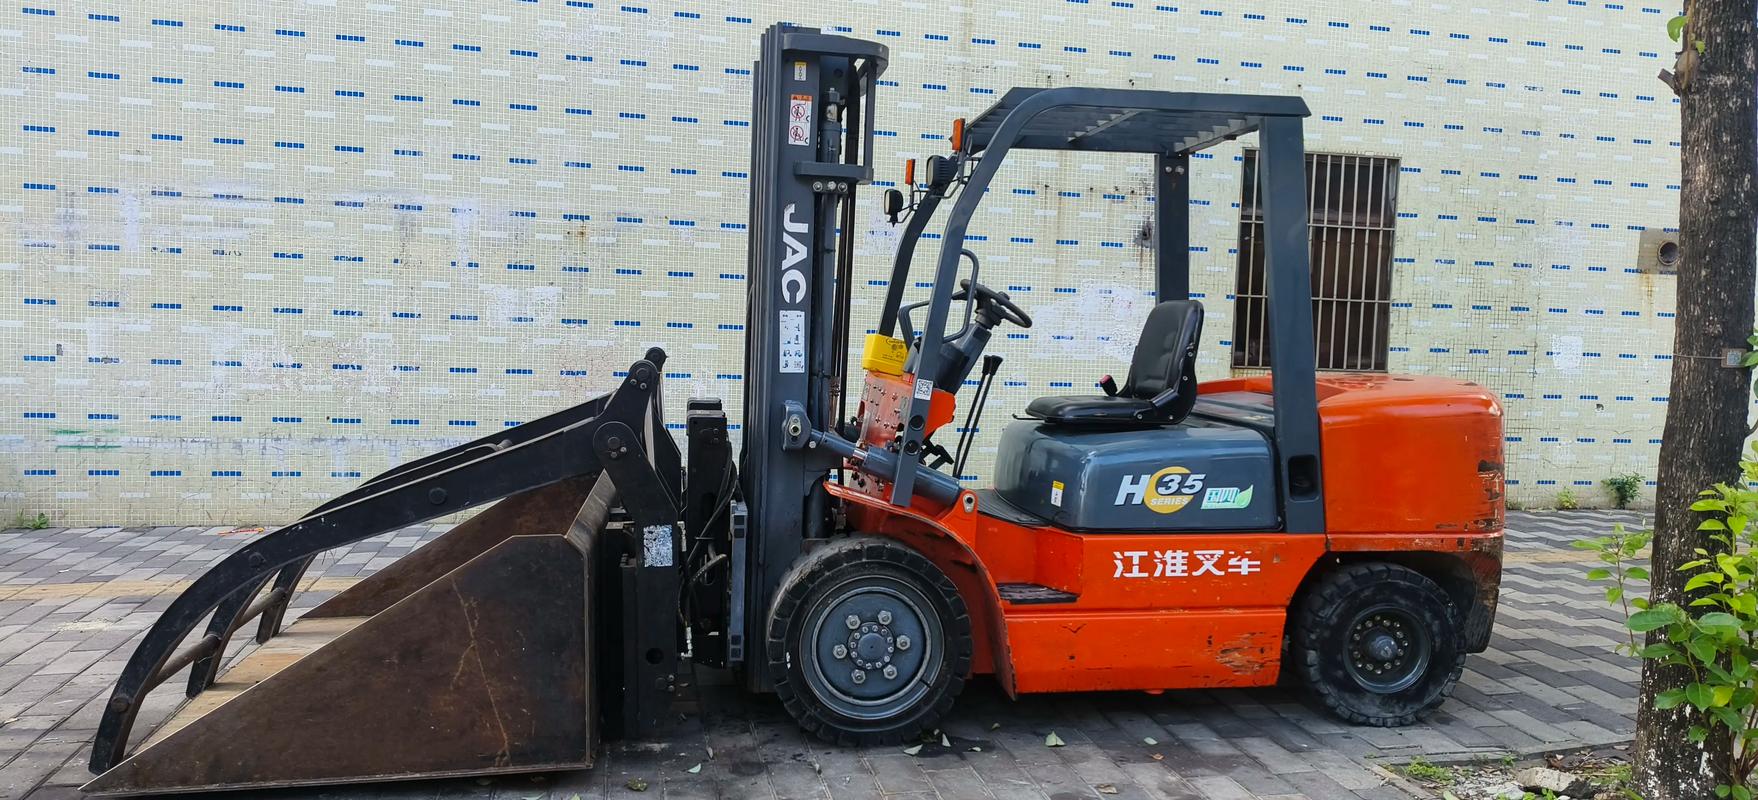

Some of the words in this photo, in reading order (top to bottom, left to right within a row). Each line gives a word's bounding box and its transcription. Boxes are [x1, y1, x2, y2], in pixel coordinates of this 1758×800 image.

[782, 203, 809, 304] JAC
[1150, 497, 1189, 506] SERIES
[1113, 549, 1261, 578] 江淮叉车
